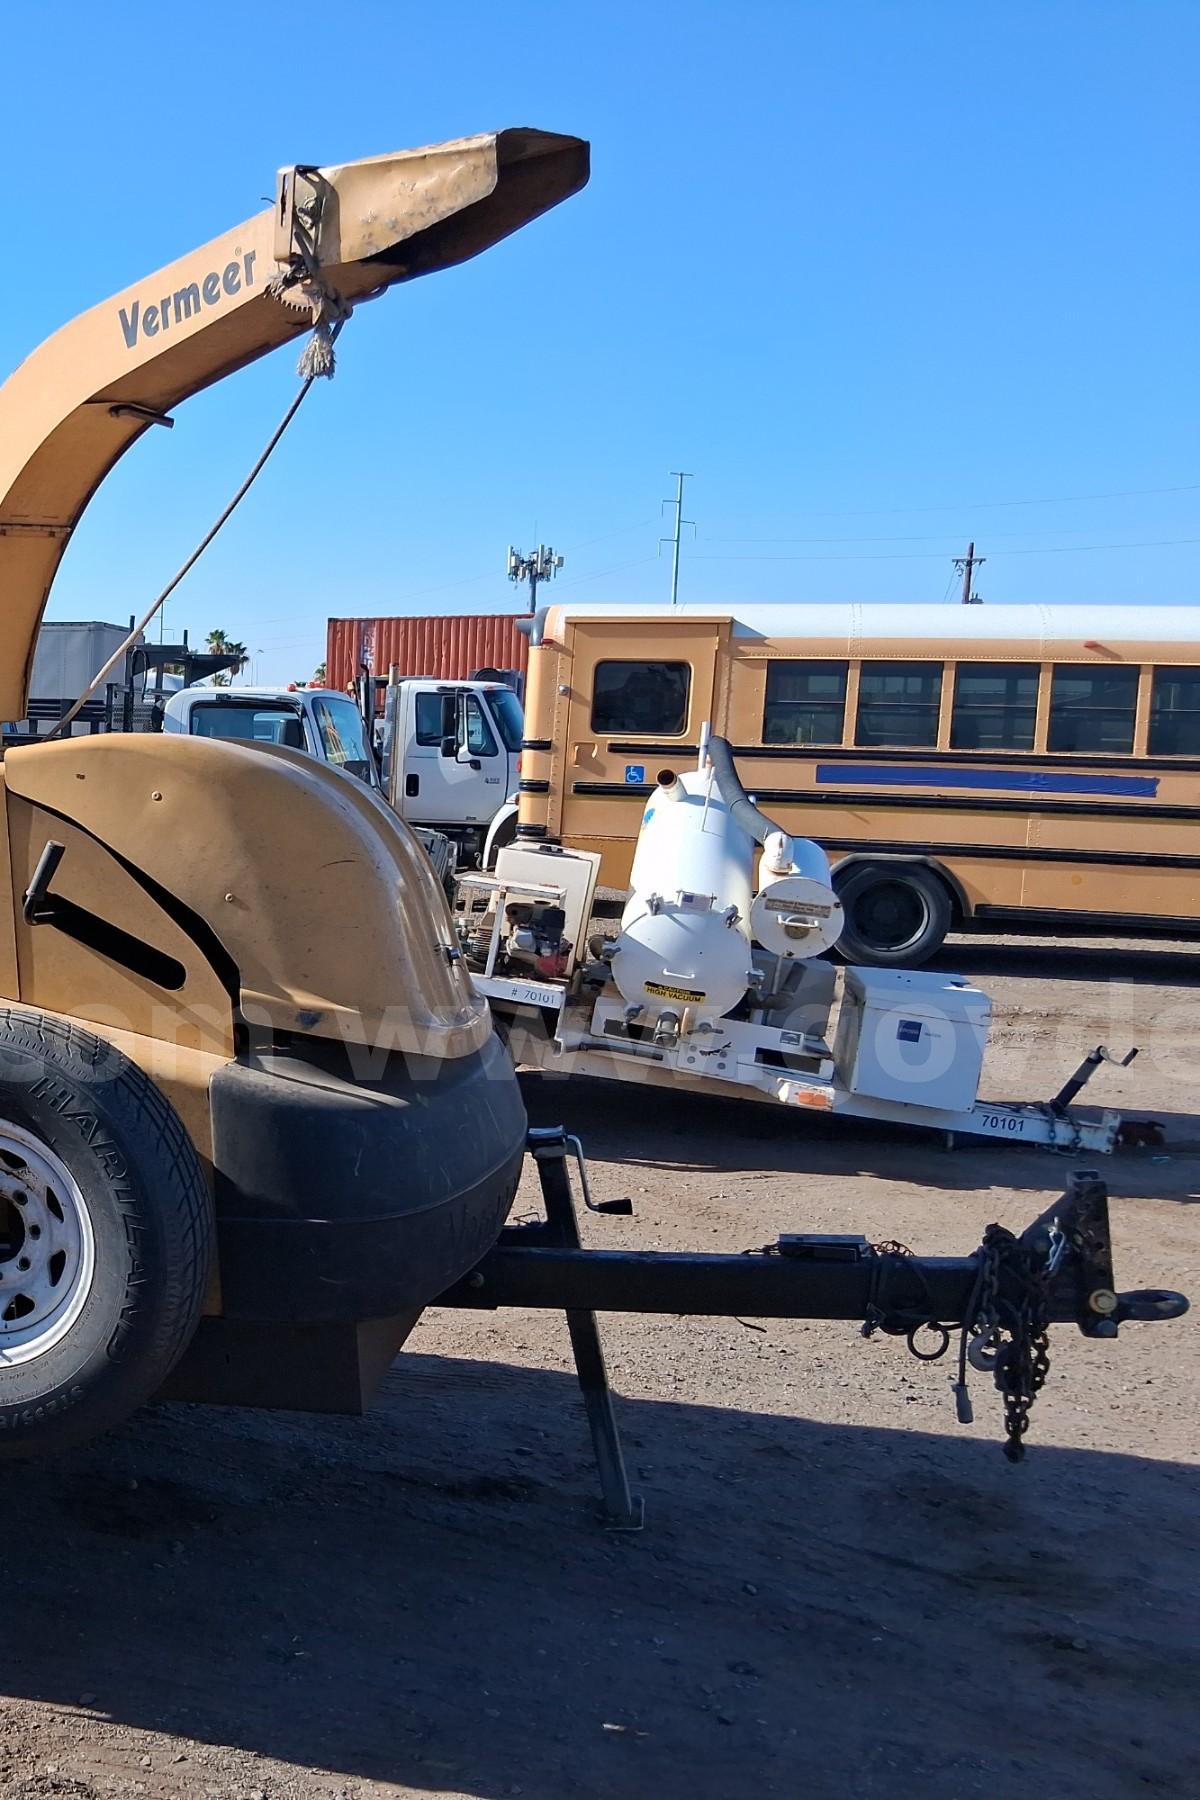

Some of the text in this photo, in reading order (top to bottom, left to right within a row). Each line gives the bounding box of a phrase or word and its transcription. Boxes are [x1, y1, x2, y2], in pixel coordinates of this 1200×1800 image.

[118, 248, 256, 349] Vermeer
[511, 987, 555, 1004] # 70101
[646, 986, 702, 1002] HIGH VACUUM
[981, 1114, 1025, 1132] 70101
